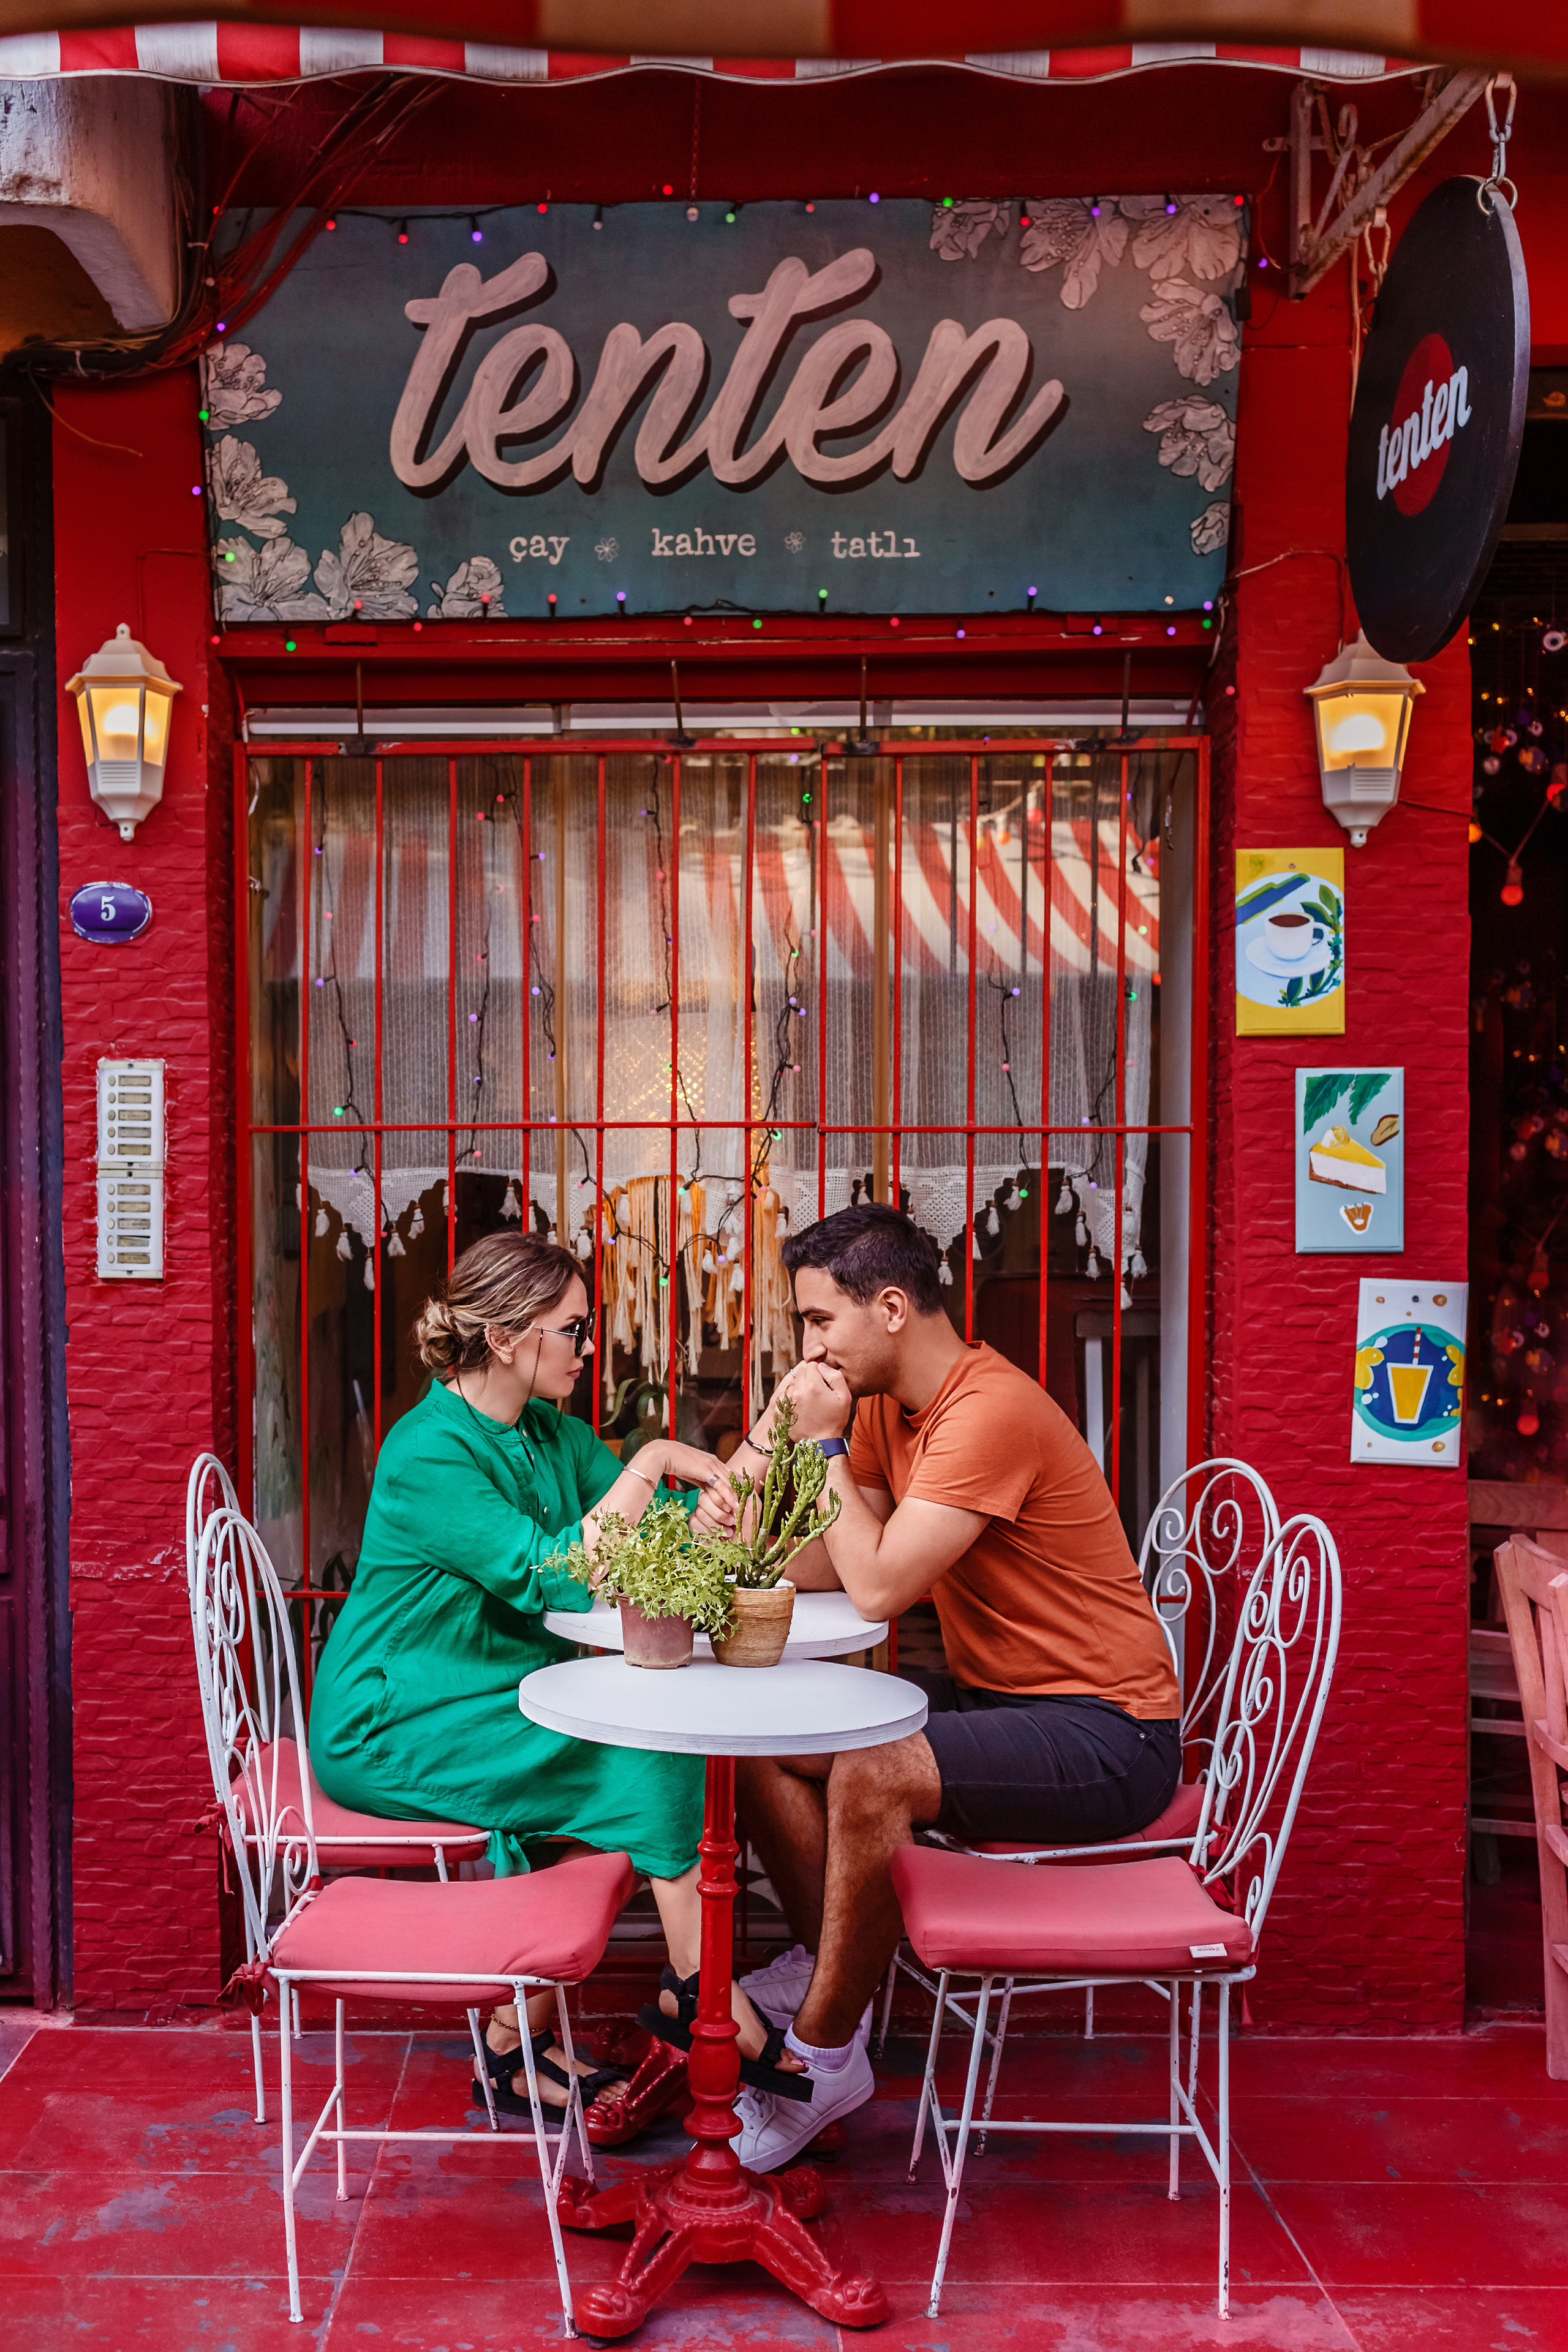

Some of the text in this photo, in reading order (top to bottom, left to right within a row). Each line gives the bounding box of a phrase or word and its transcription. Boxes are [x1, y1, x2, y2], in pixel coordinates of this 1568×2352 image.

[390, 247, 1066, 489] tenten
[1376, 365, 1472, 501] tenten
[509, 527, 921, 565] çay kahve tatlı
[100, 895, 116, 921] 5
